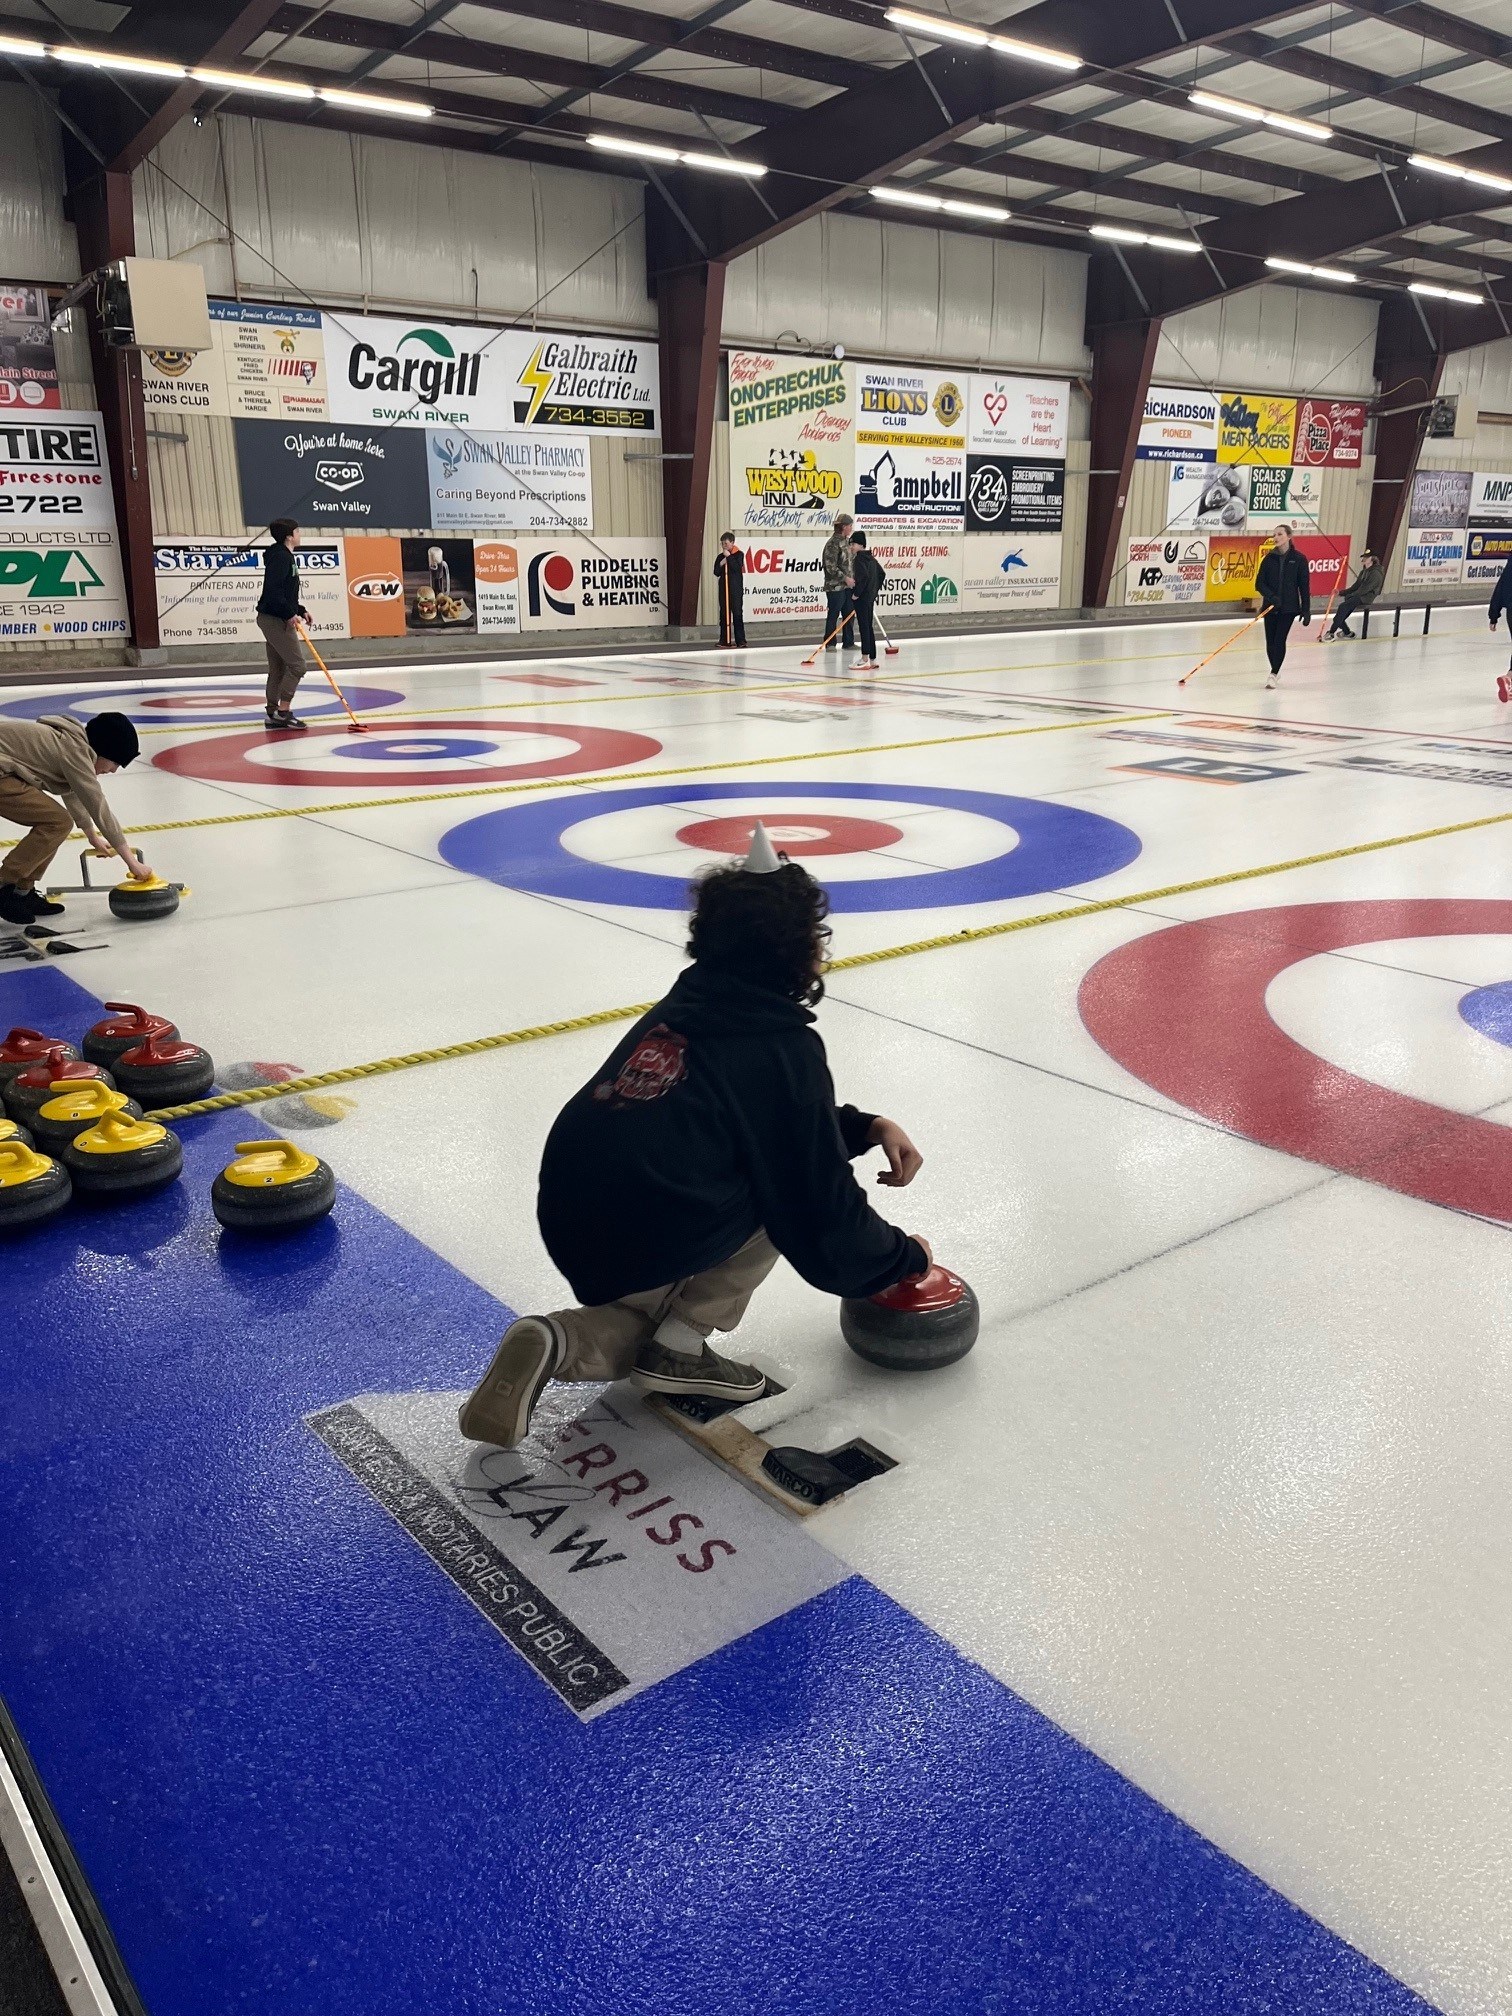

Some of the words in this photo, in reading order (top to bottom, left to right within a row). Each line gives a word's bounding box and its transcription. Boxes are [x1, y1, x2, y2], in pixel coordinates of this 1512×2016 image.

[240, 308, 264, 320] Junior
[265, 310, 294, 324] Curling
[295, 311, 316, 324] Rocks
[238, 326, 258, 334] SWAN
[239, 334, 259, 342] RIVER
[233, 342, 266, 351] SHRINERS
[544, 342, 638, 374] Galbraith
[22, 366, 58, 380] Street
[348, 343, 482, 404] Cargill
[141, 379, 174, 392] SWAN
[177, 381, 210, 393] RIVER
[555, 371, 633, 401] Electric
[632, 387, 651, 402] Ltd.
[730, 362, 844, 406] ONOFRECHUK
[865, 375, 895, 386] SWAN
[897, 377, 924, 388] RIVER
[244, 389, 266, 397] BRUCE
[143, 394, 177, 406] LIONS
[177, 395, 210, 407] CLUB
[733, 384, 846, 429] ENTERPRISES
[861, 387, 928, 416] LIONS
[305, 406, 323, 414] RIVER
[372, 408, 420, 421] SWAN
[424, 411, 470, 423] RIVER
[544, 406, 646, 426] 734-3552
[1030, 410, 1043, 419] are
[1043, 410, 1055, 420] the
[1144, 401, 1216, 420] RICHARDSON
[882, 416, 907, 426] CLUB
[1032, 422, 1052, 433] Heart
[1162, 428, 1192, 439] PIONEER
[1307, 423, 1328, 438] Pizza
[0, 428, 95, 461] TIRE
[284, 433, 326, 459] You're
[326, 435, 338, 449] at
[338, 432, 363, 449] home
[363, 437, 386, 459] here.
[859, 433, 889, 443] SERVING
[891, 434, 904, 443] THE
[905, 435, 928, 444] VALLEY
[927, 437, 948, 446] SINCE
[1021, 434, 1030, 445] of
[1221, 430, 1247, 447] MEAT
[1248, 432, 1290, 450] PACKERS
[1309, 437, 1330, 451] Place
[463, 440, 494, 463] SWAN
[496, 441, 532, 465] VALLEY
[534, 444, 585, 468] PHARMACY
[1148, 449, 1204, 459] www.richardson.ca
[0, 470, 102, 486] Firestone
[532, 469, 549, 477] Swan
[549, 470, 567, 478] Valley
[568, 470, 586, 479] Co-op
[1173, 466, 1185, 481] IG
[1252, 468, 1287, 483] SCALES
[746, 467, 843, 498] WESTWOOD
[968, 473, 1004, 501] 734
[1011, 482, 1045, 494] EMBROIDERY
[1255, 482, 1281, 497] DRUG
[436, 488, 472, 502] Caring
[475, 489, 516, 502] Beyond
[519, 490, 587, 503] Prescriptions
[1483, 480, 1512, 502] MNP
[0, 494, 83, 514] 2722
[765, 492, 796, 506] INN
[1011, 493, 1046, 506] PROMOTIONAL
[1046, 495, 1063, 506] ITEMS
[1252, 496, 1282, 510] STORE
[312, 501, 339, 512] Swan
[340, 501, 371, 515] Valley
[897, 504, 962, 512] CONSTRUCTION
[530, 516, 588, 527] 204-734-2882
[78, 532, 114, 544] LTD.
[897, 546, 917, 558] LEVEL
[921, 545, 949, 557] SEATING
[1129, 552, 1150, 562] NORTH
[1407, 545, 1432, 560] VALLEY
[1432, 545, 1463, 559] BEARING
[156, 548, 223, 571] Star
[224, 552, 248, 567] and
[580, 558, 659, 573] RIDDELL'S
[742, 546, 785, 574] ACE
[884, 559, 913, 570] donated
[915, 558, 925, 570] by
[1210, 551, 1257, 571] CLEAN
[1308, 558, 1341, 573] OGERS
[476, 564, 490, 575] Open
[489, 564, 498, 574] 24
[498, 563, 516, 574] Hours
[190, 581, 234, 590] PRINTERS
[235, 581, 255, 589] AND
[581, 575, 660, 590] PLUMBING
[1007, 577, 1039, 585] INSURANCE
[1039, 576, 1059, 584] GROUP
[356, 583, 400, 596] A&W
[752, 586, 781, 595] Avenue
[783, 585, 808, 594] South,
[206, 594, 219, 603] the
[581, 592, 594, 607] &
[598, 590, 660, 606] HEATING
[769, 595, 819, 604] 204-734-3224
[19, 603, 66, 616] 1942
[216, 605, 230, 614] for
[0, 622, 37, 635] MBER
[53, 622, 88, 633] WOOD
[92, 620, 126, 632] CHIPS
[163, 628, 192, 637] Phone
[197, 627, 238, 636] 734-3858
[308, 622, 344, 632] 734-4935
[560, 1419, 737, 1574] RRISS
[487, 1473, 628, 1574] LAW
[420, 1506, 520, 1604] NOTARIES
[505, 1600, 599, 1686] PUBLIC
